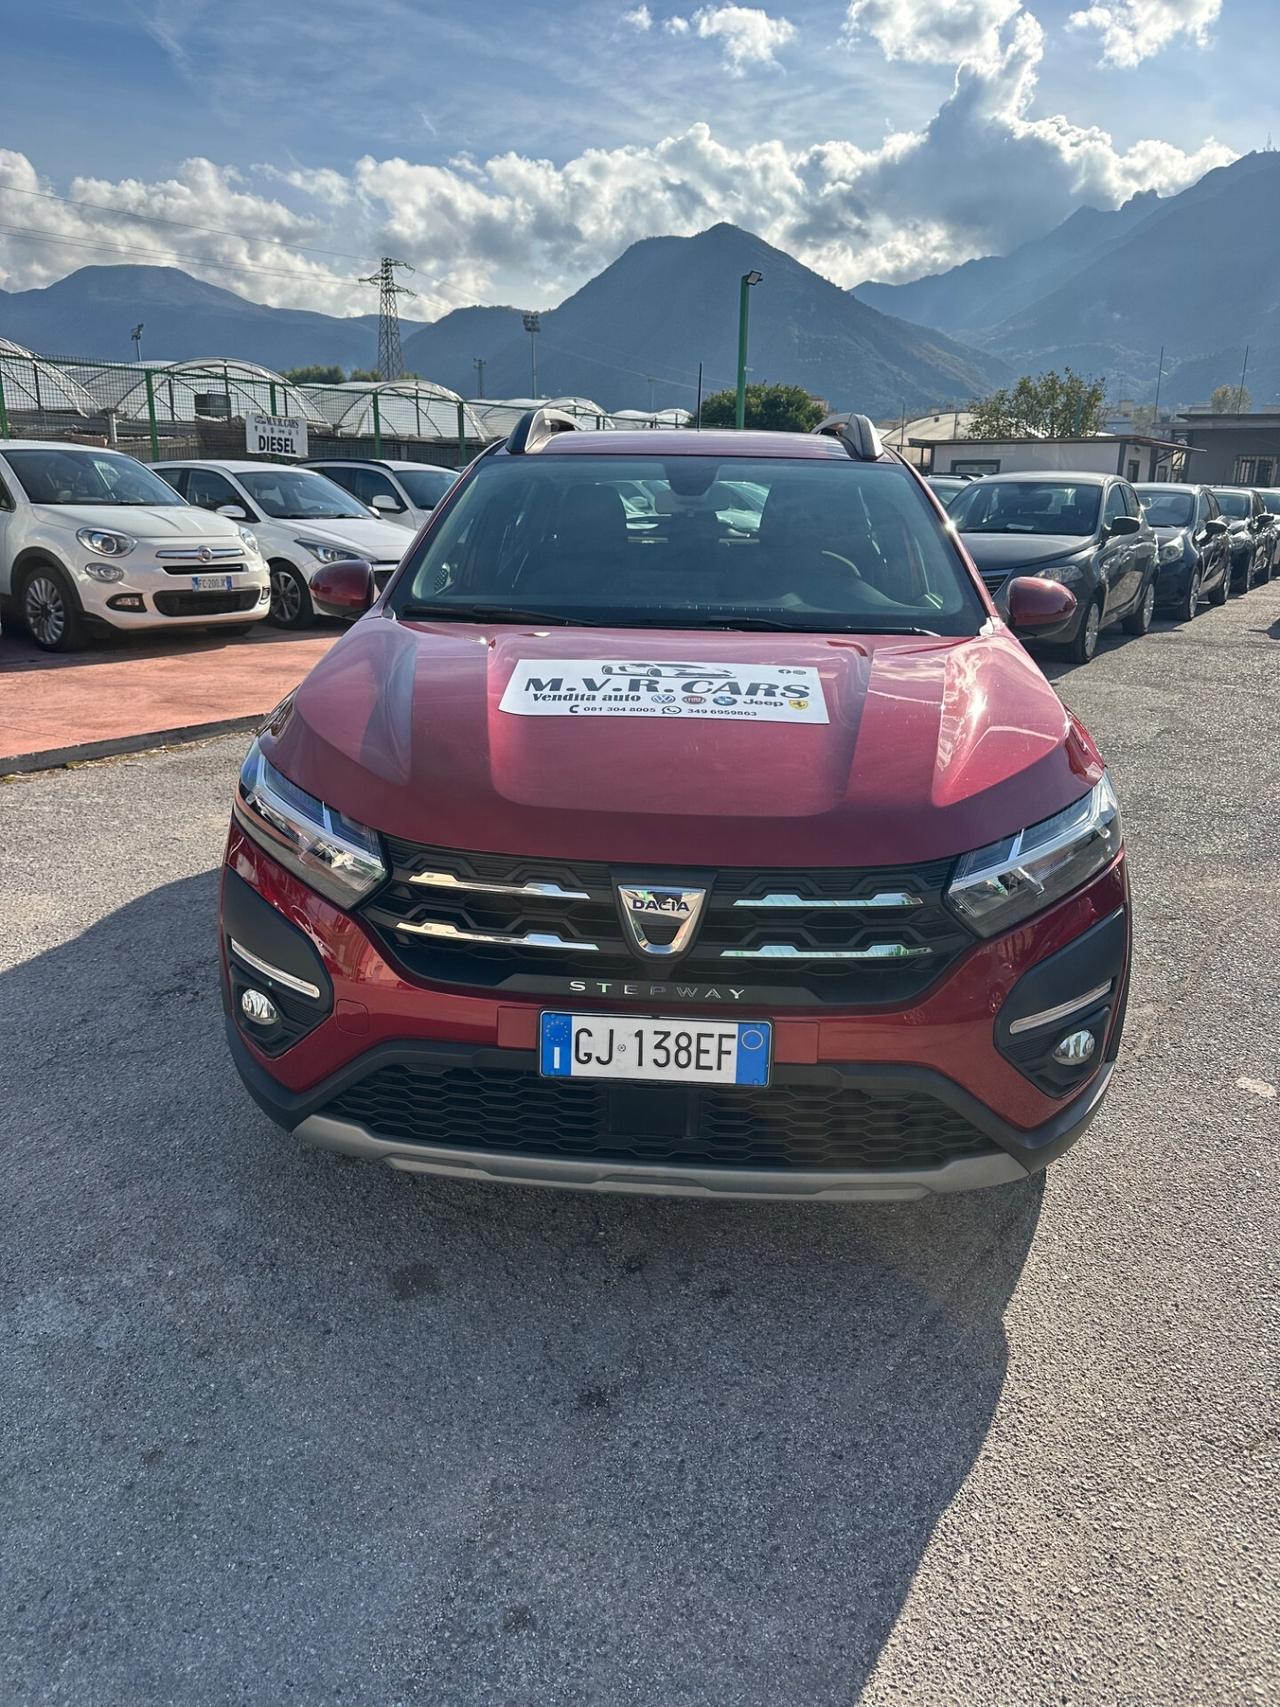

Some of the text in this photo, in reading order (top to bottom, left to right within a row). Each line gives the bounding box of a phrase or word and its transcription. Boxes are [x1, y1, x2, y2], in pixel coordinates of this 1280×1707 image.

[259, 435, 296, 454] DIESEL
[532, 693, 641, 702] Vendita auto
[743, 699, 784, 708] Jeep
[632, 899, 690, 912] DACIA
[569, 980, 745, 999] STEPWAY
